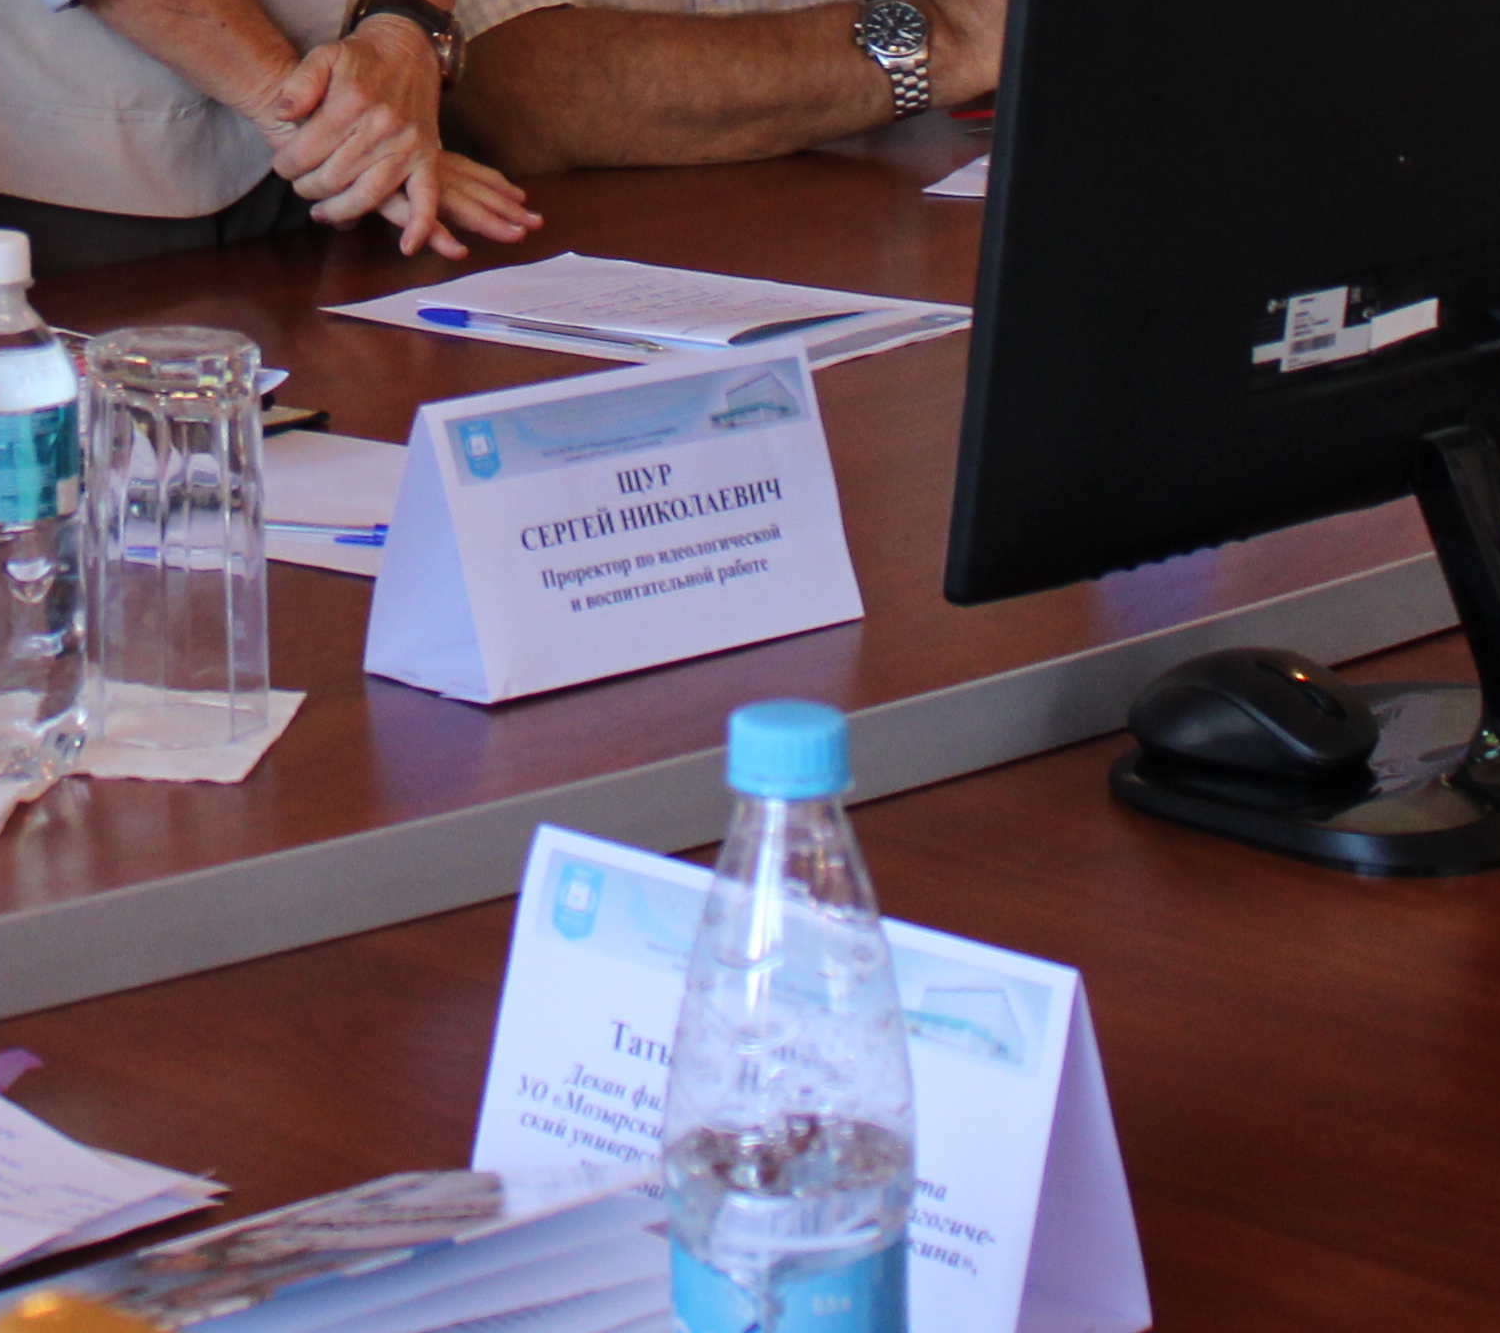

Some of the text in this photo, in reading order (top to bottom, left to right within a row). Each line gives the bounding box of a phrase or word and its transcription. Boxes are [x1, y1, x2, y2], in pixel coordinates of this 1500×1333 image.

[615, 462, 673, 497] ЩУР
[520, 477, 784, 553] СЕРГЕЙ НИКОЛАЕВИЧ
[540, 522, 783, 592] Проректор по идеологической
[571, 555, 770, 614] и воспитательной работе
[611, 1019, 674, 1070] Тать
[563, 1062, 628, 1101] Декан
[517, 1073, 549, 1104] УО
[552, 1089, 665, 1143] «Мозырски
[520, 1111, 568, 1140] ский
[909, 1207, 997, 1246] гогиче-
[908, 1237, 979, 1277] кина»,
